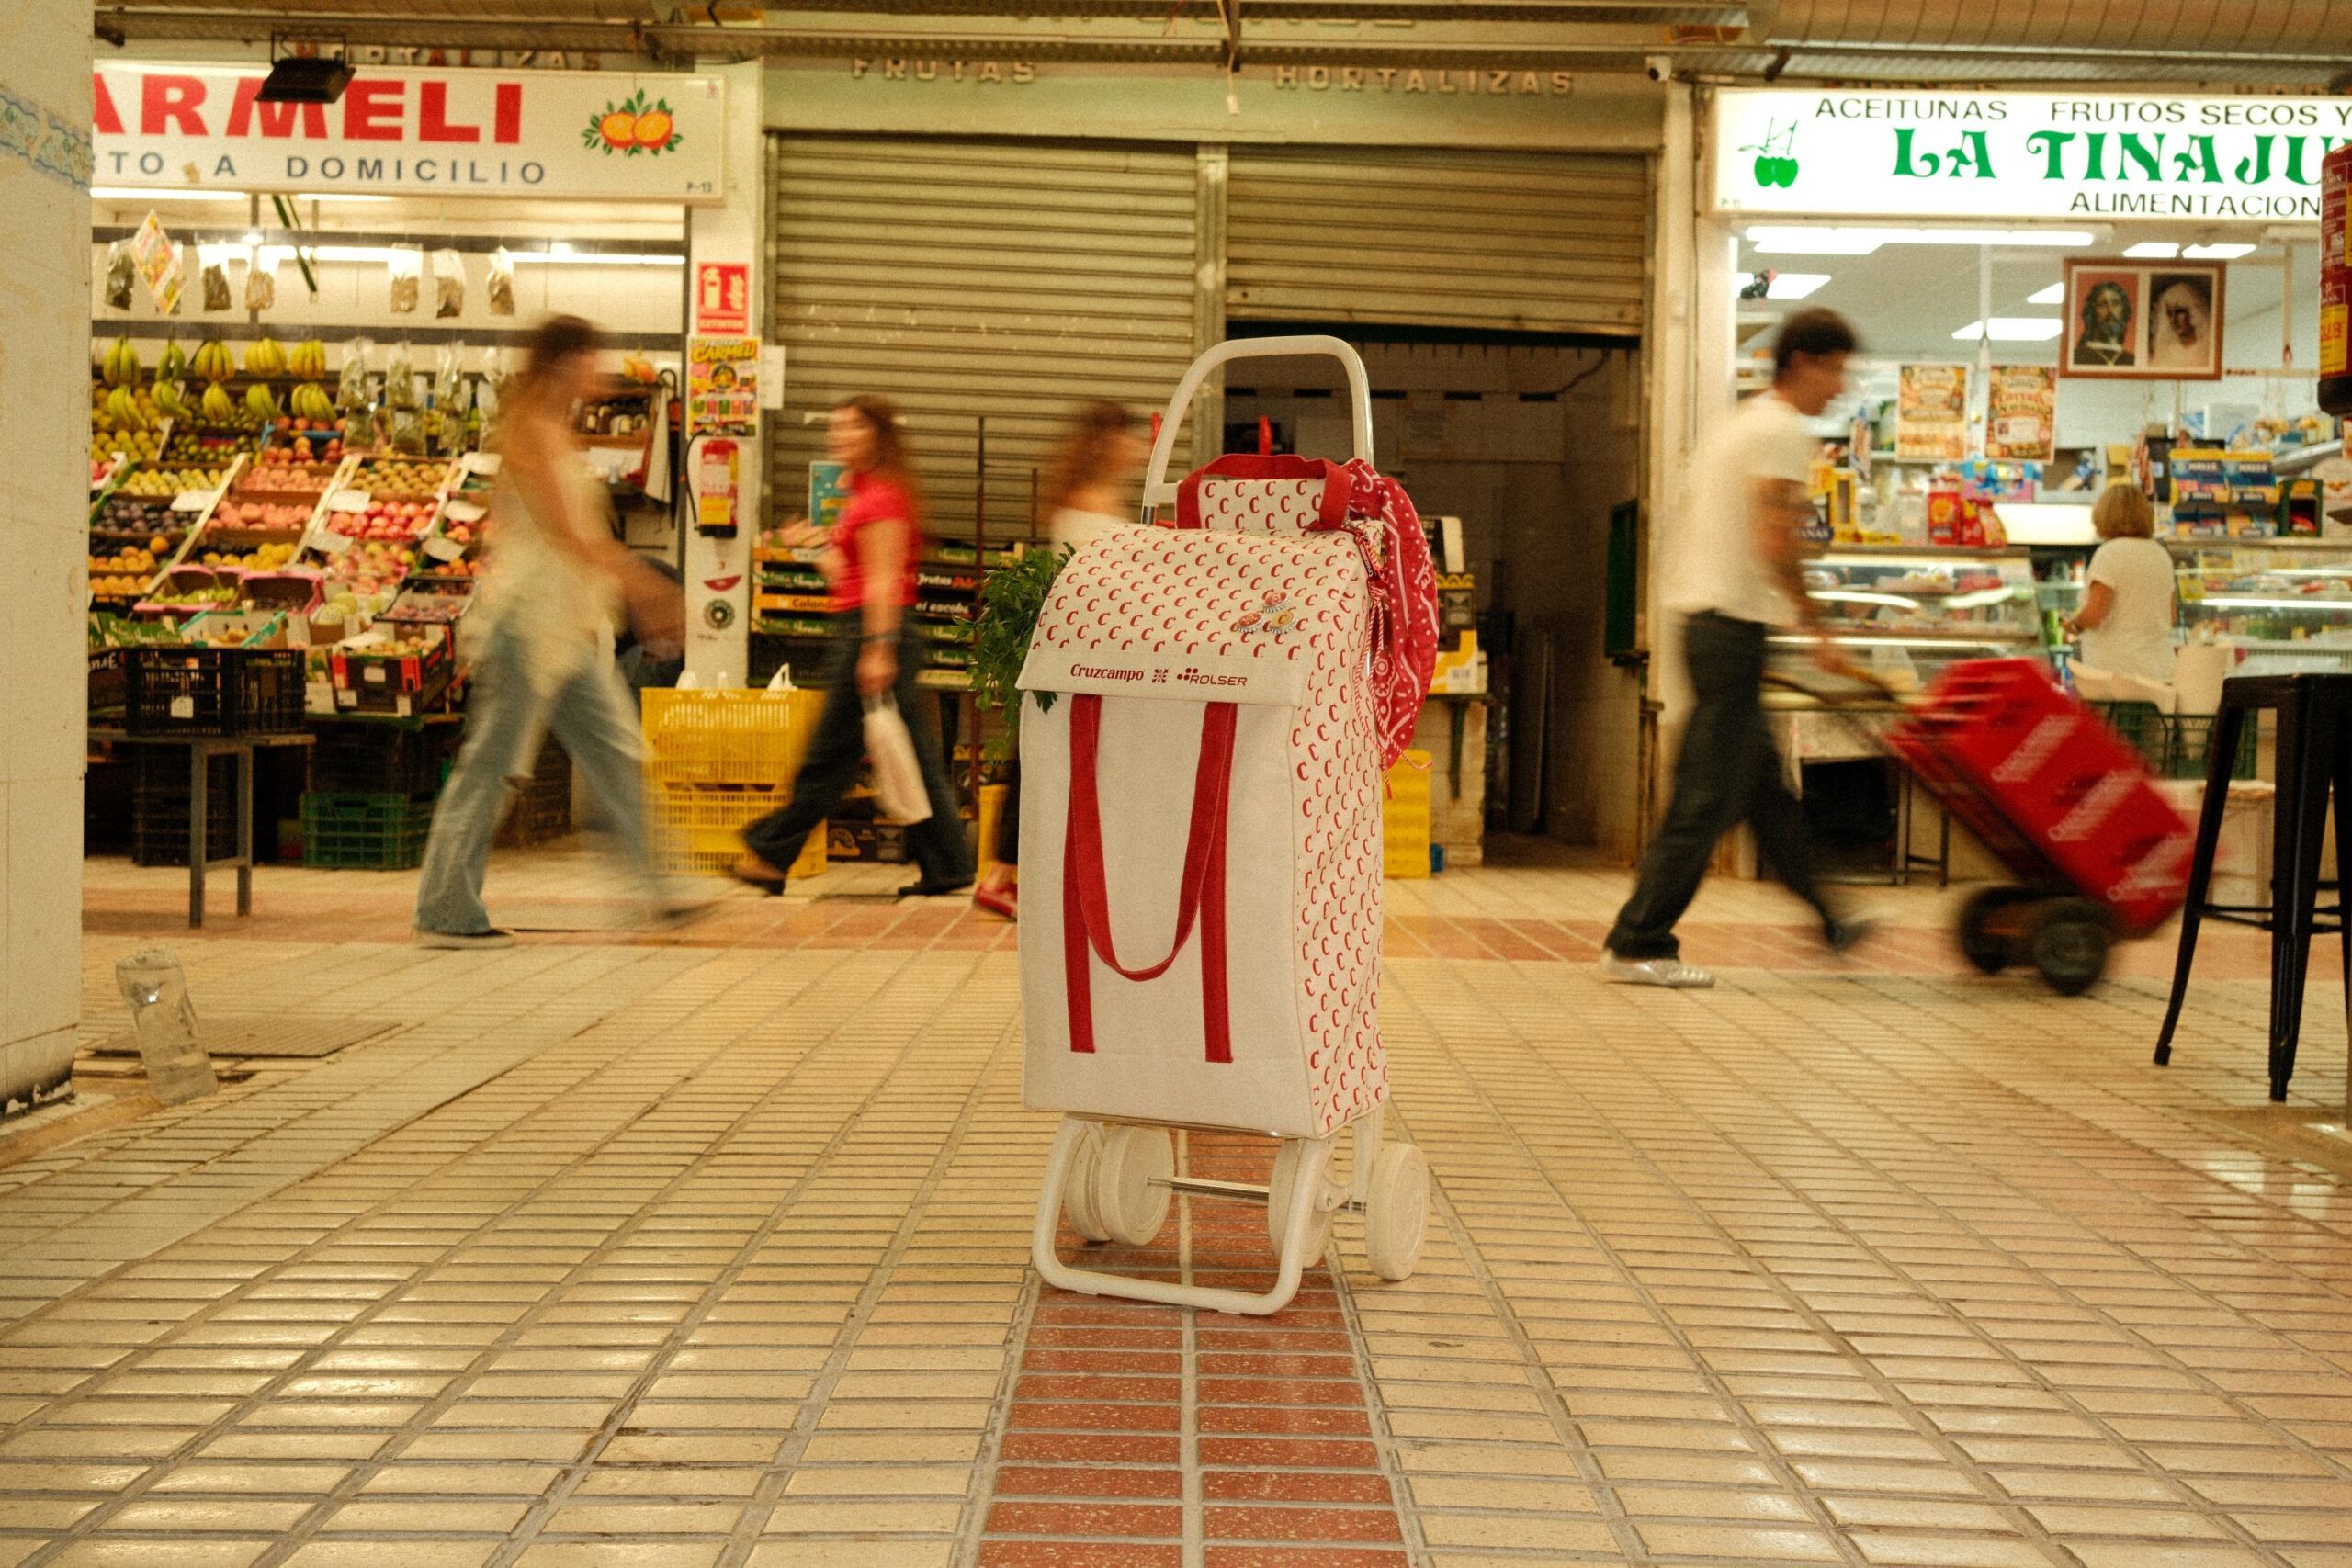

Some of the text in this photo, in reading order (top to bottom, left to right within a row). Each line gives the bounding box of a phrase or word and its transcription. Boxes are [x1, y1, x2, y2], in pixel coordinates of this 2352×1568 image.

[853, 58, 1035, 82] FRUTAS
[1276, 66, 1574, 95] HORTALIZAS
[1815, 97, 2007, 120] ACEITUNAS
[2052, 101, 2186, 123] FRUTOS
[2200, 104, 2319, 126] SECOS
[92, 152, 545, 185] TO A DOMICILIO
[1892, 127, 2352, 186] LA TINAJU
[2069, 192, 2321, 217] ALIMENTACION
[1069, 663, 1146, 682] Cruzcampo
[1190, 674, 1248, 687] ROLSER
